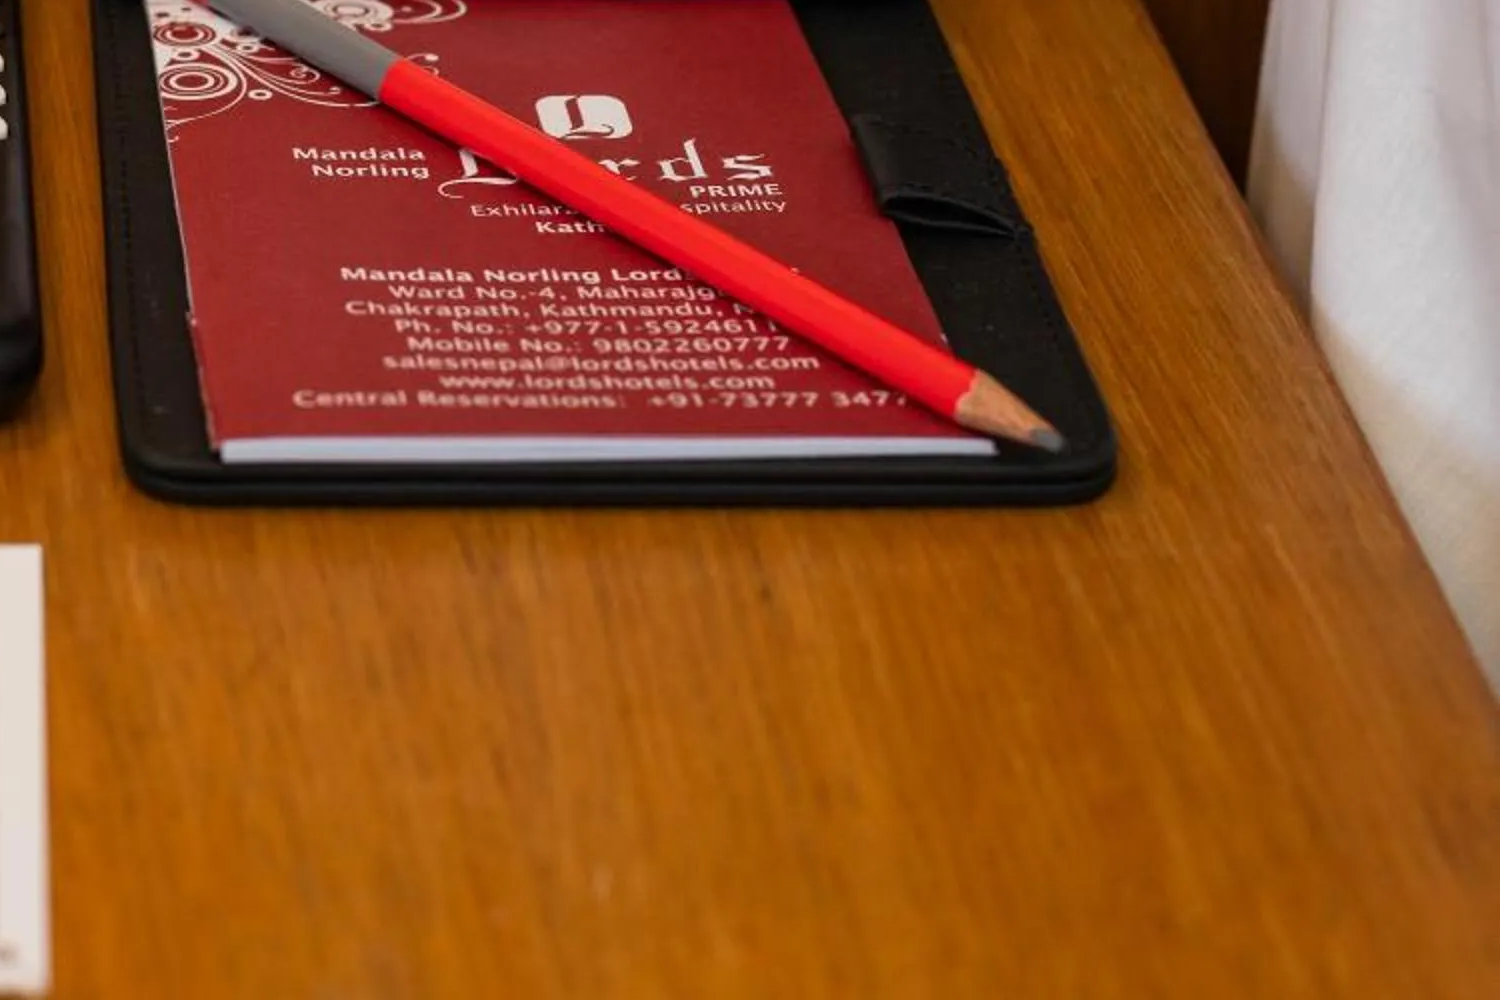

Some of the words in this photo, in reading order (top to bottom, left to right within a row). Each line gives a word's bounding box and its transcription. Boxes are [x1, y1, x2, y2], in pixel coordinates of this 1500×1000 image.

[293, 147, 426, 161] Mandala
[311, 164, 430, 179] Norling
[437, 137, 773, 198] Lrds
[689, 183, 783, 197] PRIME
[470, 203, 574, 217] Exhilar
[680, 199, 787, 214] spitality
[535, 219, 605, 233] Kath
[340, 267, 474, 282] Mandala
[483, 268, 600, 284] Norling
[612, 268, 684, 282] Lord
[388, 285, 465, 299] Ward
[578, 285, 719, 300] Maharajg
[345, 300, 530, 318] Chakrapath,
[540, 302, 723, 318] Kathmandu,
[395, 318, 441, 334] Ph.
[406, 336, 510, 353] Mobile
[593, 336, 789, 353] 9802260777
[382, 353, 821, 374] salesnepal@lordshotels.com
[438, 374, 775, 391] www.lordshotels.com
[292, 389, 408, 409] Central
